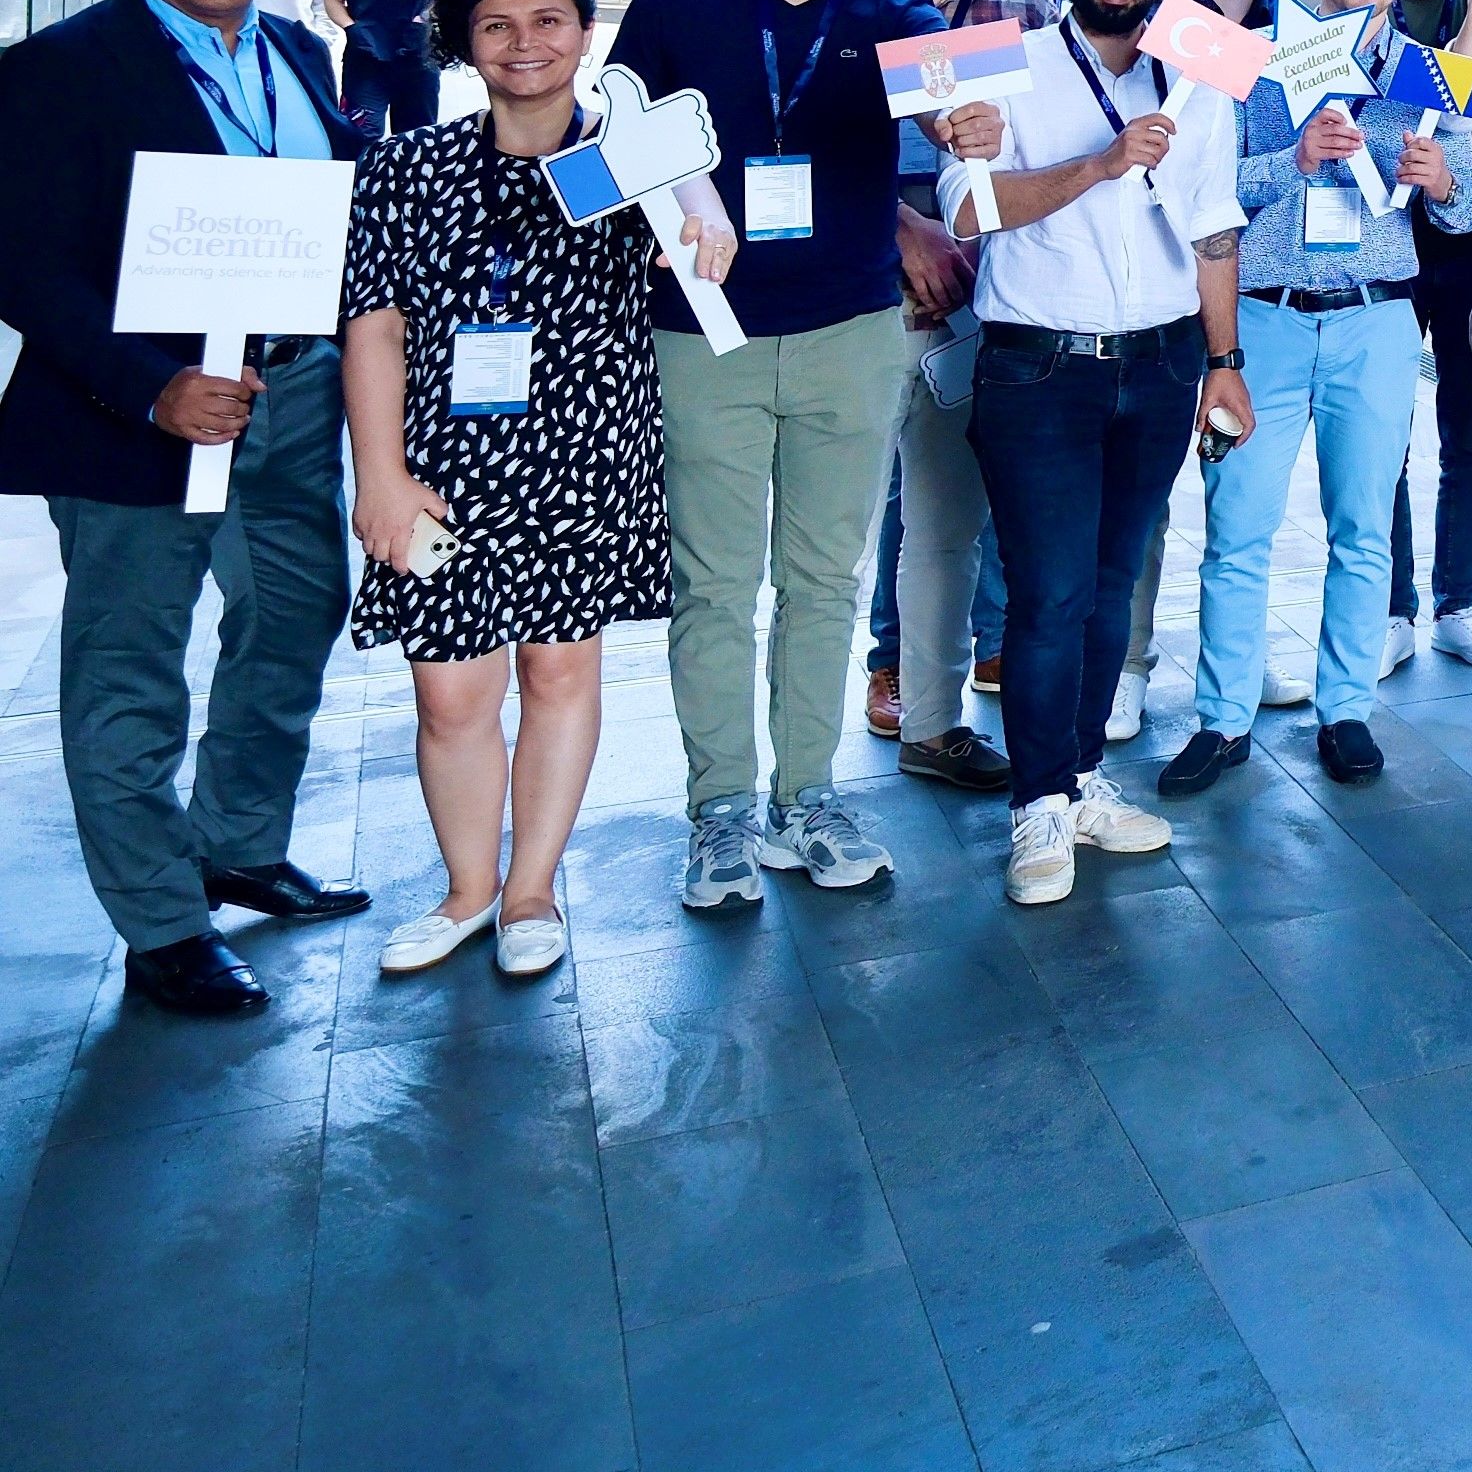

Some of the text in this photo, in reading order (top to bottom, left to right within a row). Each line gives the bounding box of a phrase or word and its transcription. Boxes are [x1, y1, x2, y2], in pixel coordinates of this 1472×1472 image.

[1265, 24, 1346, 66] ndovascular
[1283, 47, 1343, 79] Excellence
[1292, 63, 1350, 96] Academy
[174, 206, 284, 235] Boston
[145, 224, 323, 260] Scientific
[131, 264, 213, 280] Advancing
[219, 266, 273, 278] science
[277, 267, 297, 278] for
